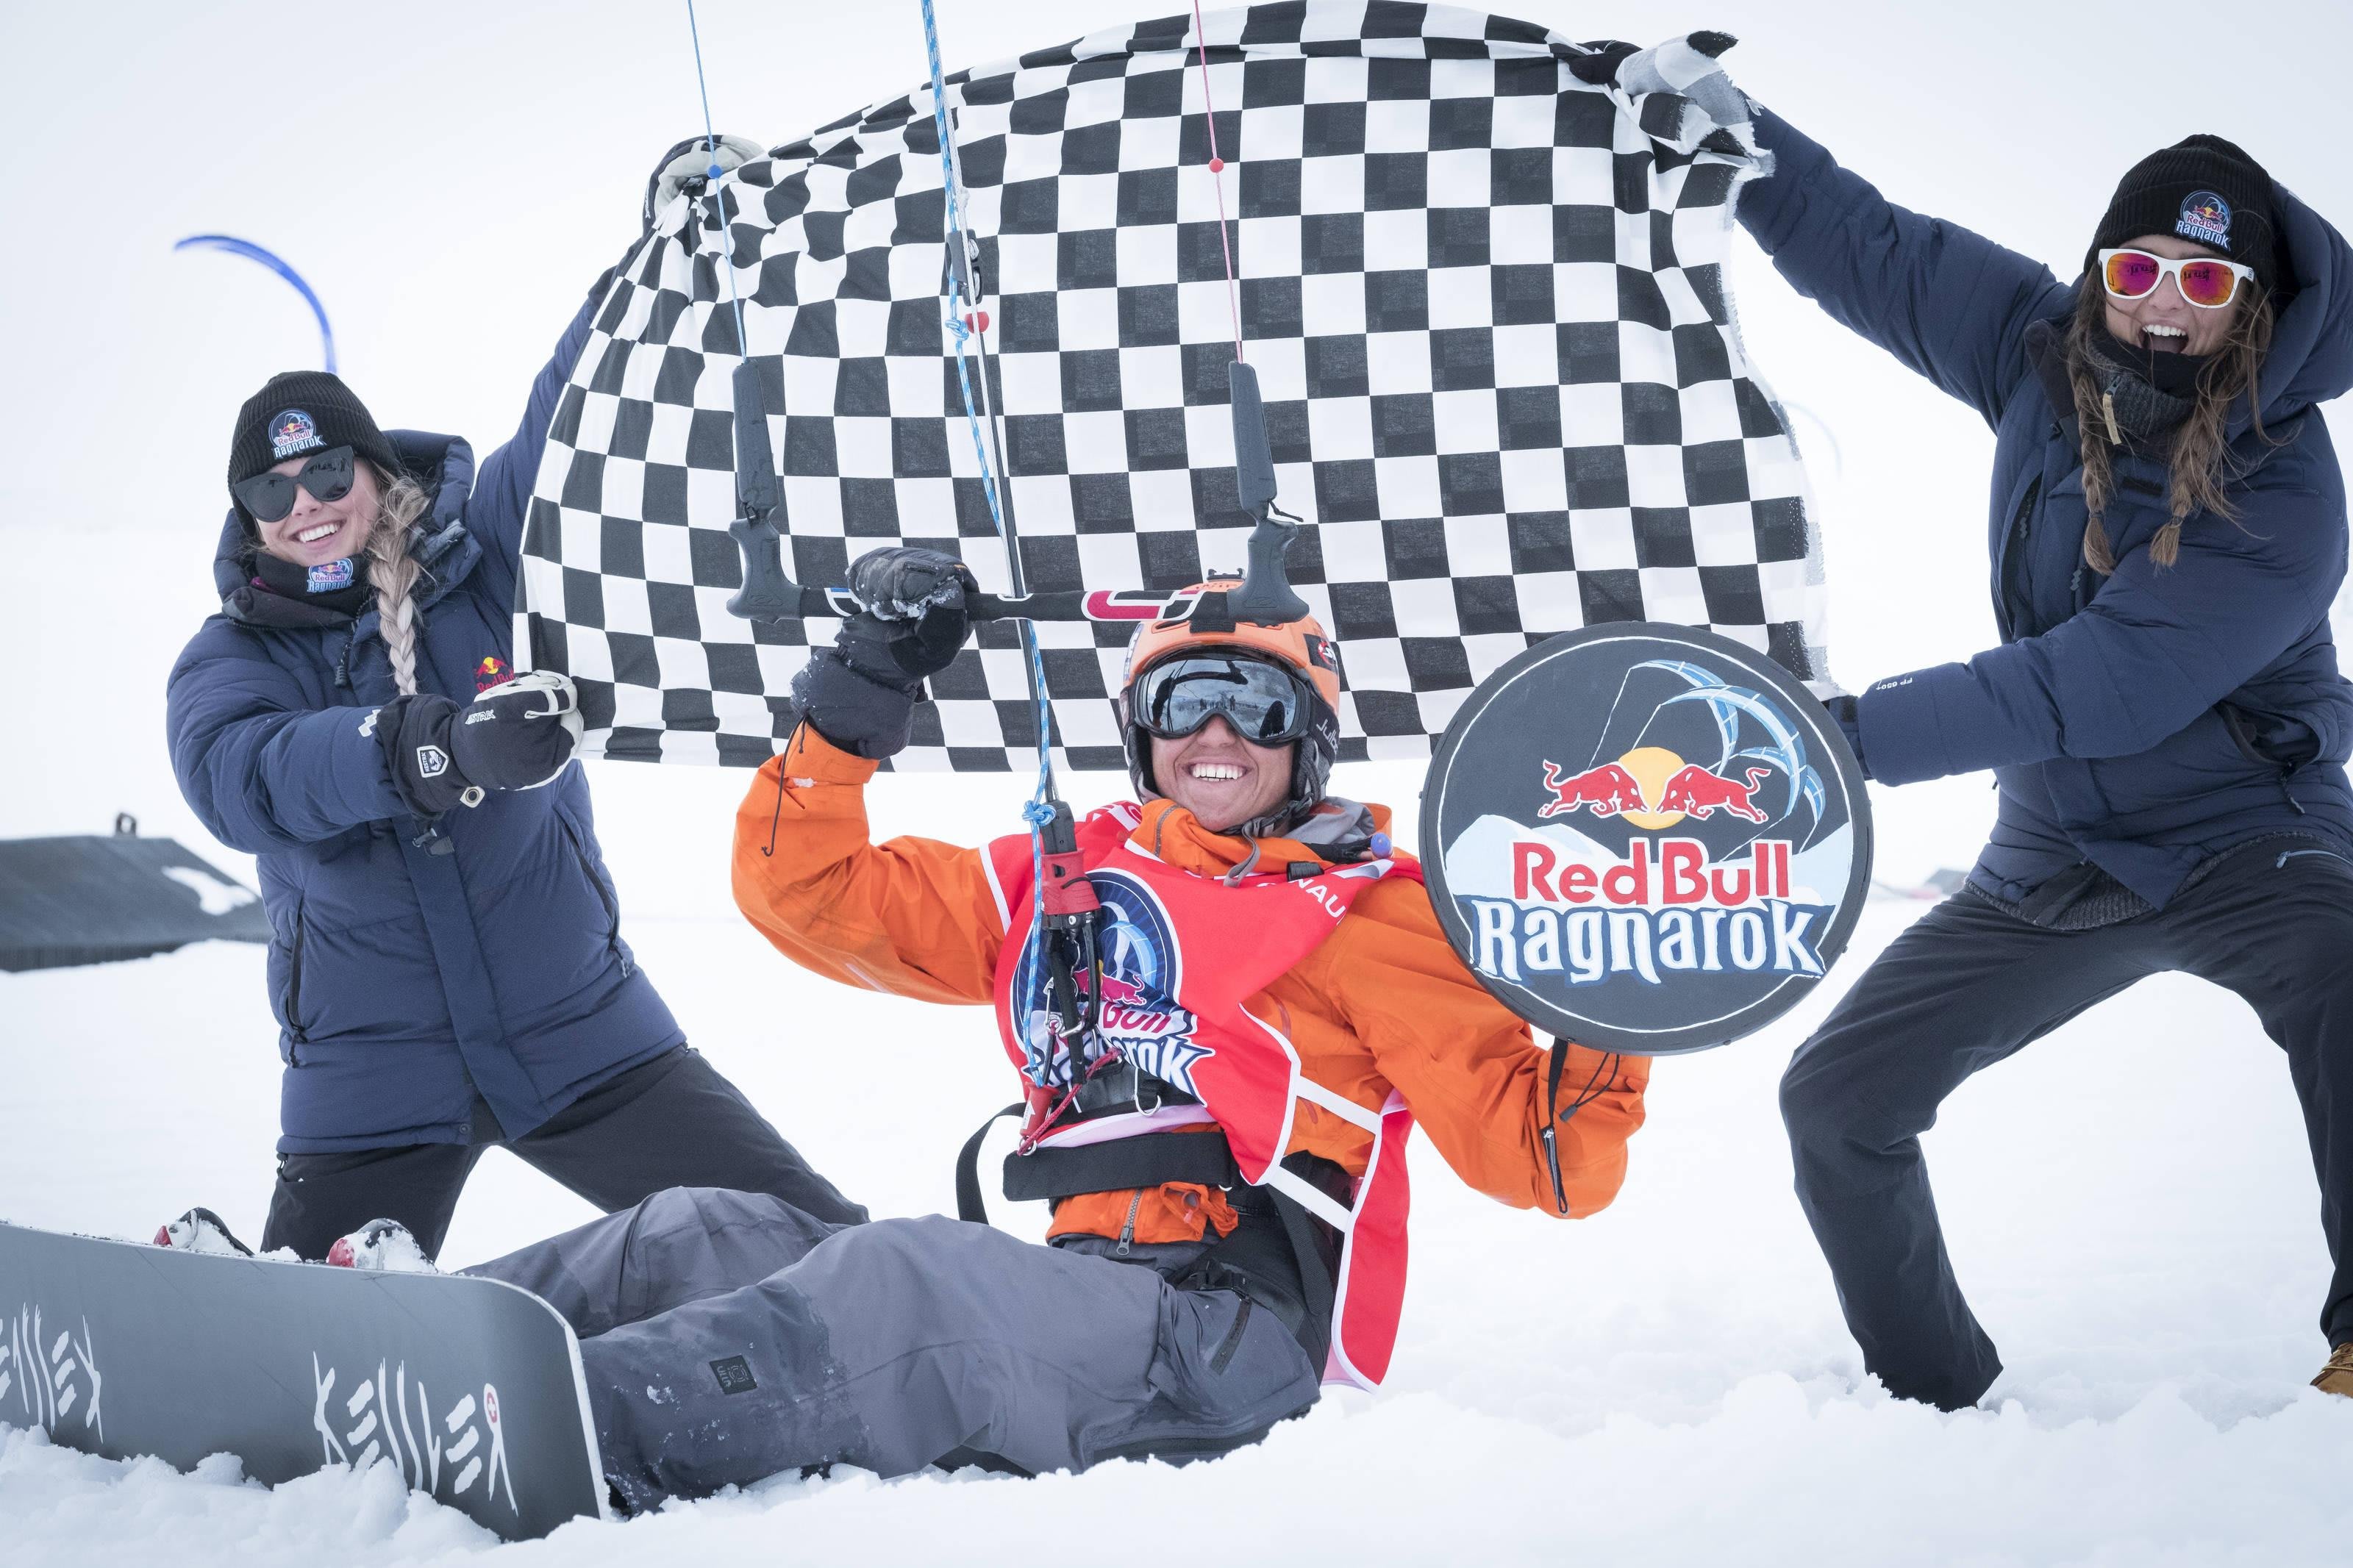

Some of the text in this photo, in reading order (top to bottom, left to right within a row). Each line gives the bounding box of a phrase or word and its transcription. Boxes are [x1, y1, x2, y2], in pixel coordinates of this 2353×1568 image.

[2177, 219, 2231, 251] Ragnarok
[2188, 215, 2224, 232] Red Bull
[274, 435, 326, 459] Ragnarok
[278, 430, 310, 445] Red Bull
[1512, 841, 1790, 906] Red Bull
[1473, 900, 1825, 984] Ragnarok
